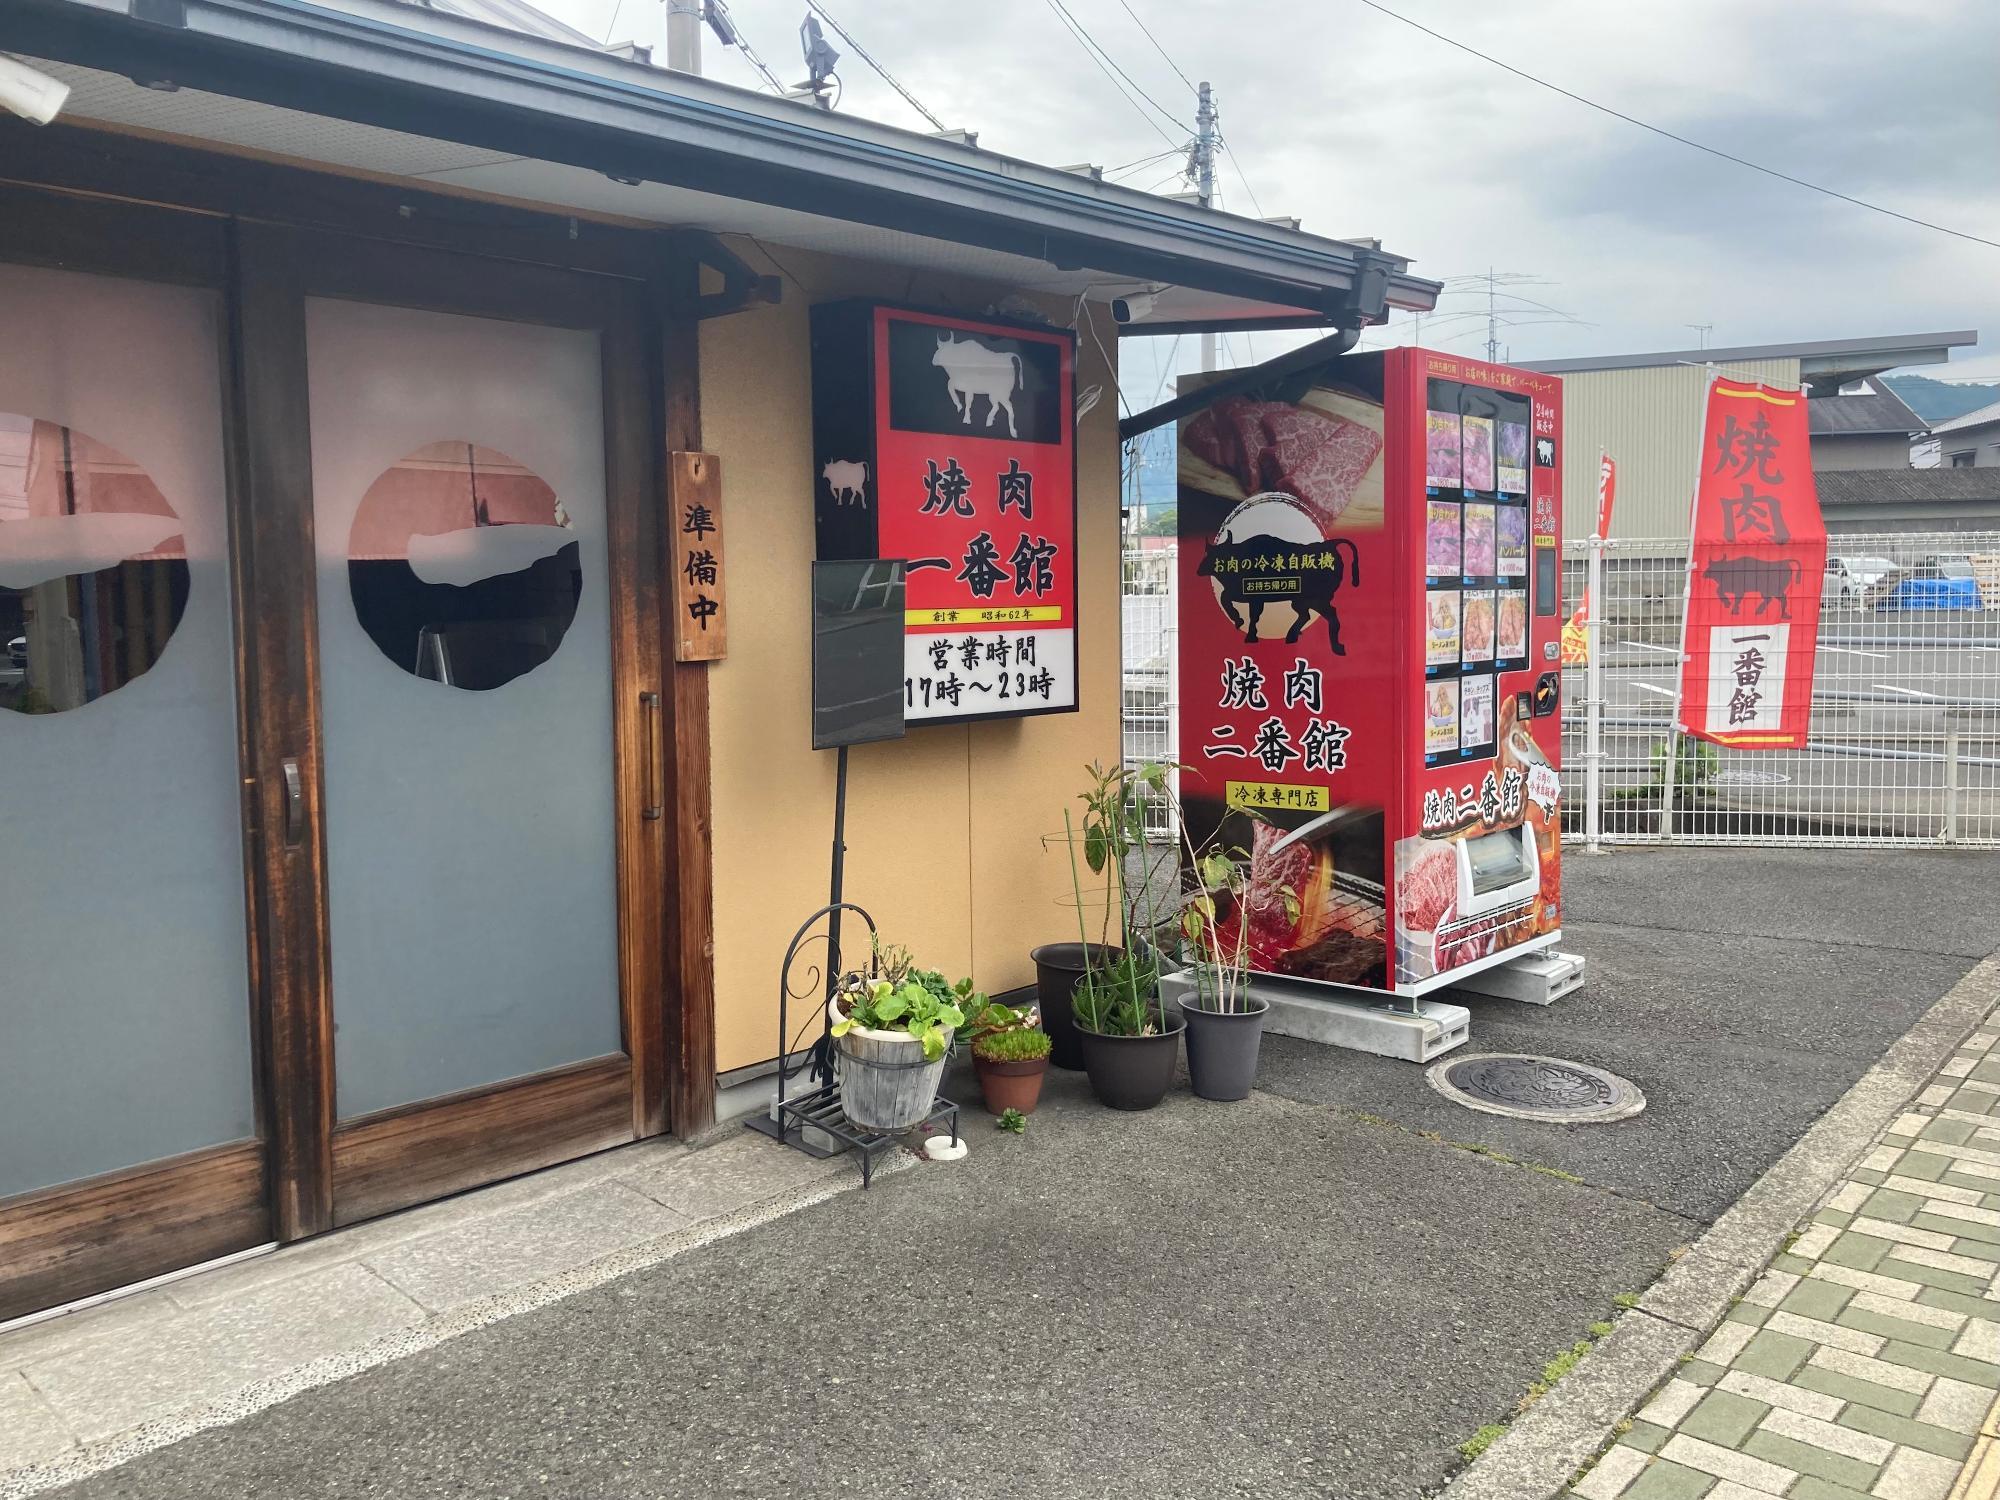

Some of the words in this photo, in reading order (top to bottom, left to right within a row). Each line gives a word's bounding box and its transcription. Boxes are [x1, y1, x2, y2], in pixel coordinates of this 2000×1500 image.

[920, 457, 1034, 520] 焼肉
[1713, 411, 1792, 545] 焼肉
[683, 504, 720, 631] 準備中
[905, 531, 1059, 600] 一番館
[1213, 553, 1336, 574] お肉の冷凍自販機
[1246, 578, 1298, 592] お持ち帰り用
[932, 609, 961, 623] 創業
[981, 608, 1034, 621] 昭和62年
[927, 634, 1037, 669] 営業時間
[1726, 633, 1771, 726] 一番館
[1221, 656, 1322, 712] 焼肉
[1204, 717, 1350, 772] 二番館
[1234, 785, 1320, 808] 冷凍専門店
[1424, 769, 1521, 826] 焼肉二番館
